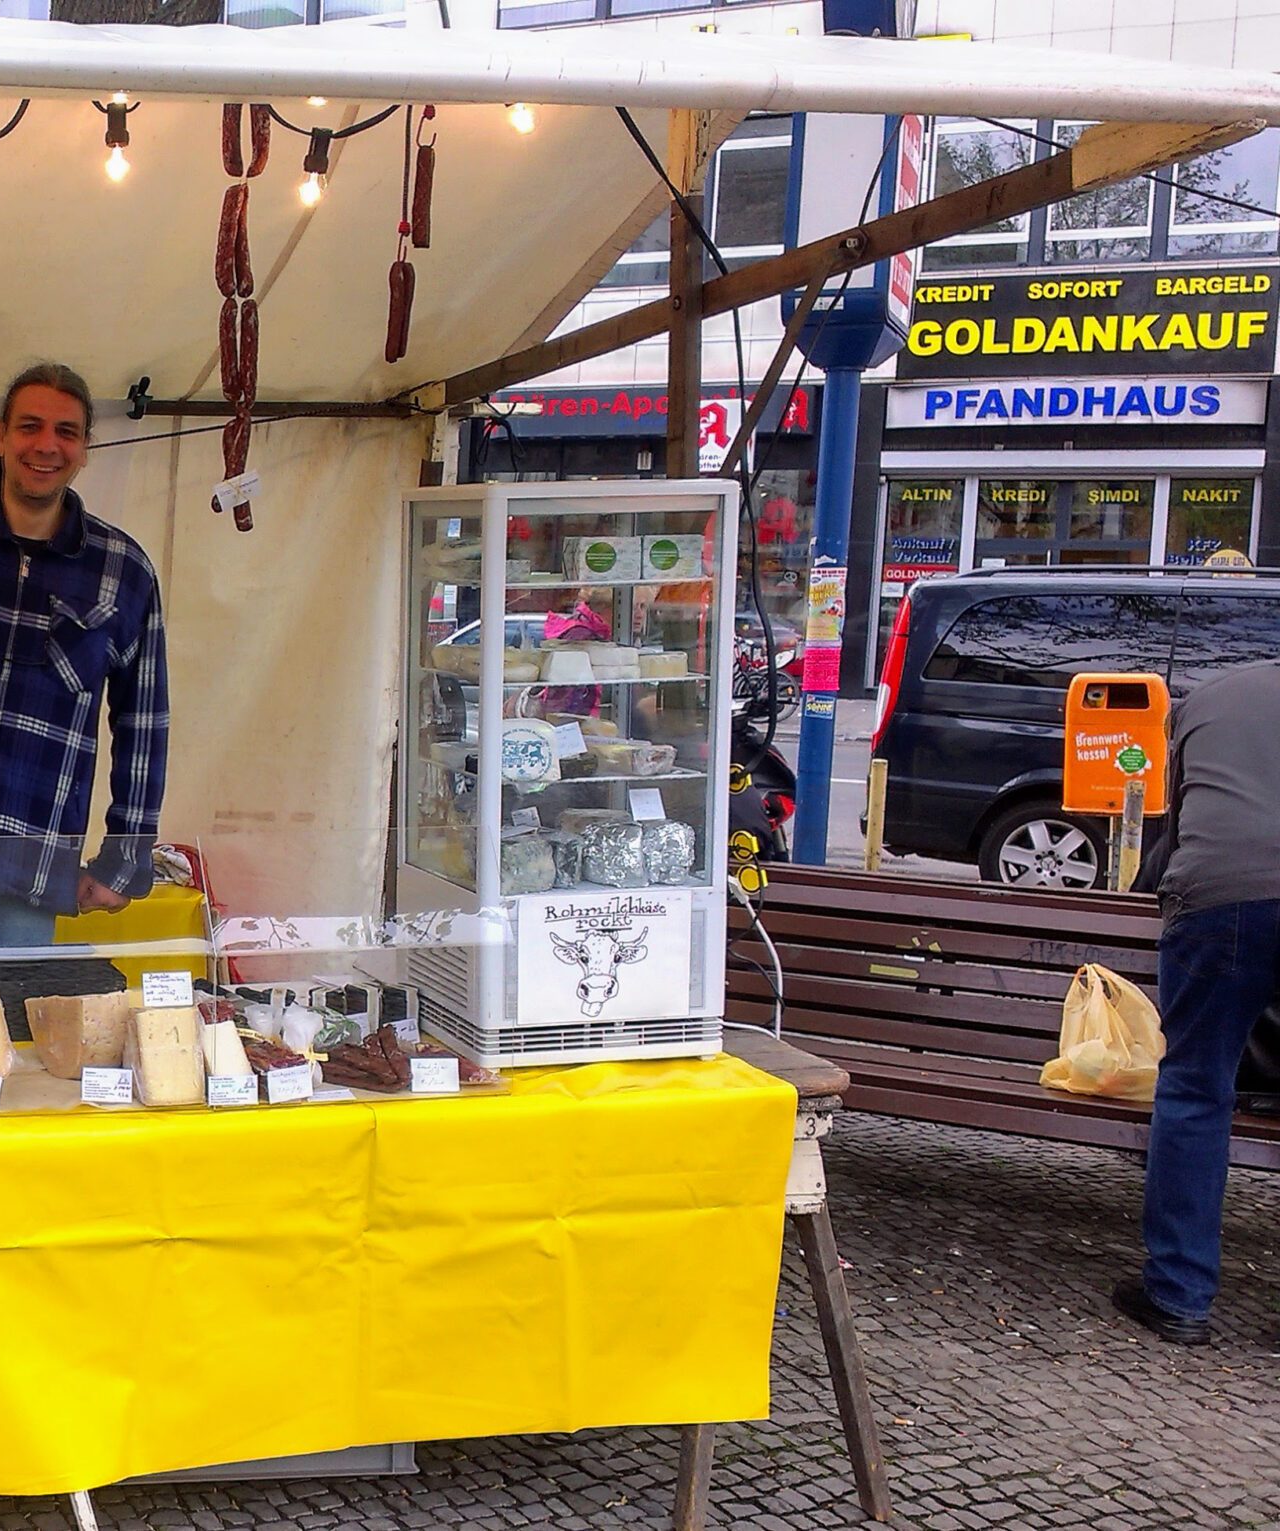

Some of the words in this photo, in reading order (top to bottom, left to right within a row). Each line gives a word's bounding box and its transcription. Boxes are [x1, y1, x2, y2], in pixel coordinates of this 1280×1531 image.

[915, 285, 995, 303] KREDIT
[1027, 280, 1122, 299] SOFORT
[1155, 275, 1271, 296] BARGELD
[907, 311, 1269, 356] GOLDANKAUF
[924, 385, 1221, 420] PFANDHAUS
[901, 488, 953, 501] ALTIN
[1182, 488, 1241, 502] NAKIT
[1075, 731, 1133, 748] Brennwert-
[1076, 746, 1110, 762] kessel
[544, 896, 667, 920] Rohmilchkäse
[575, 911, 633, 929] rockt
